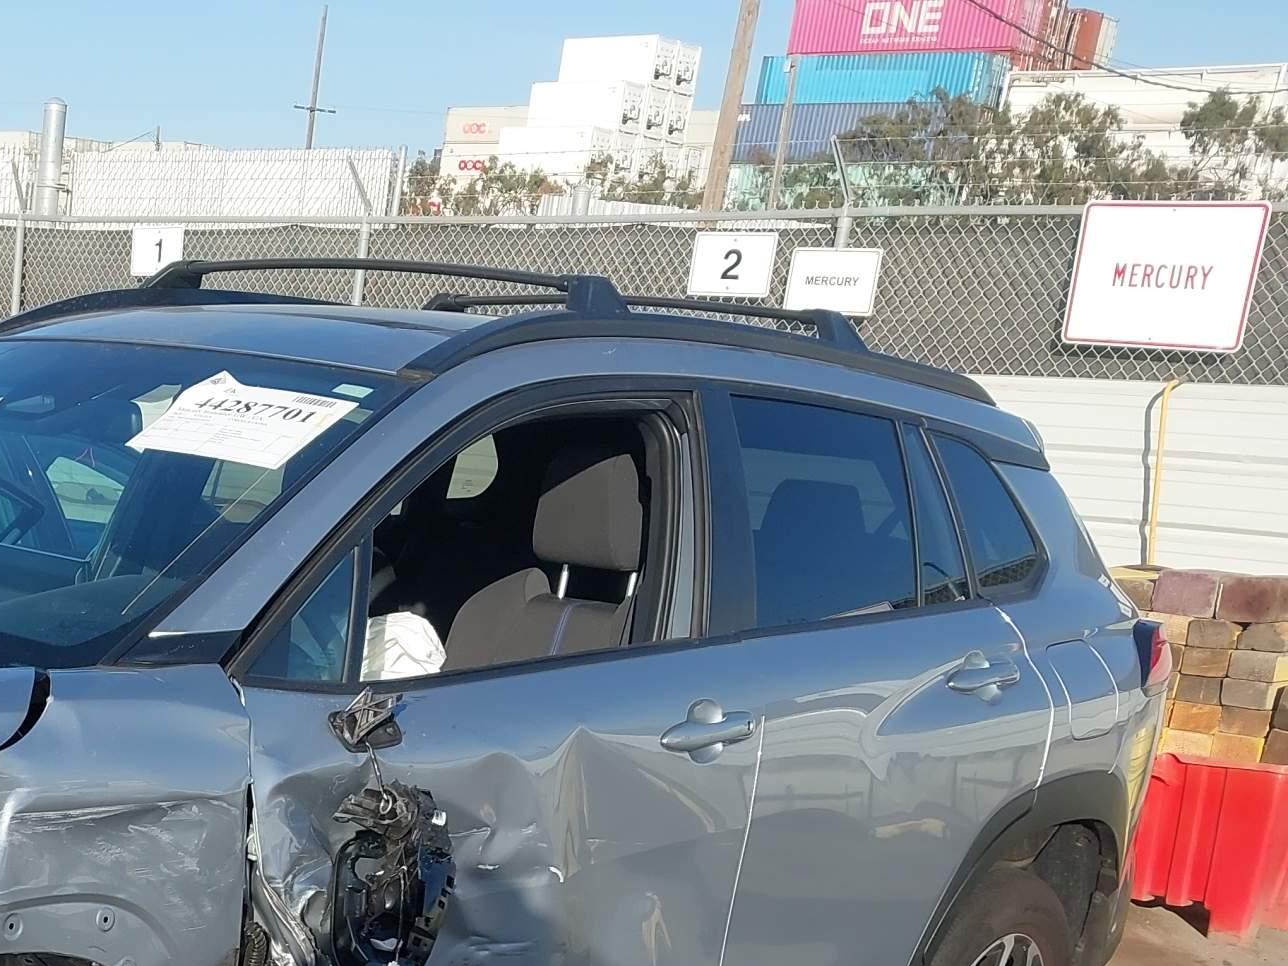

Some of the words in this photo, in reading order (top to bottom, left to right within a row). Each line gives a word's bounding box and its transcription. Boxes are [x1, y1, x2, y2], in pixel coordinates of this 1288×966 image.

[860, 0, 944, 34] ONE
[463, 123, 492, 134] OOC
[155, 238, 163, 263] 1
[720, 249, 743, 280] 2
[805, 275, 860, 287] MERCURY
[1112, 262, 1214, 290] MERCURY
[194, 396, 316, 424] 44287701
